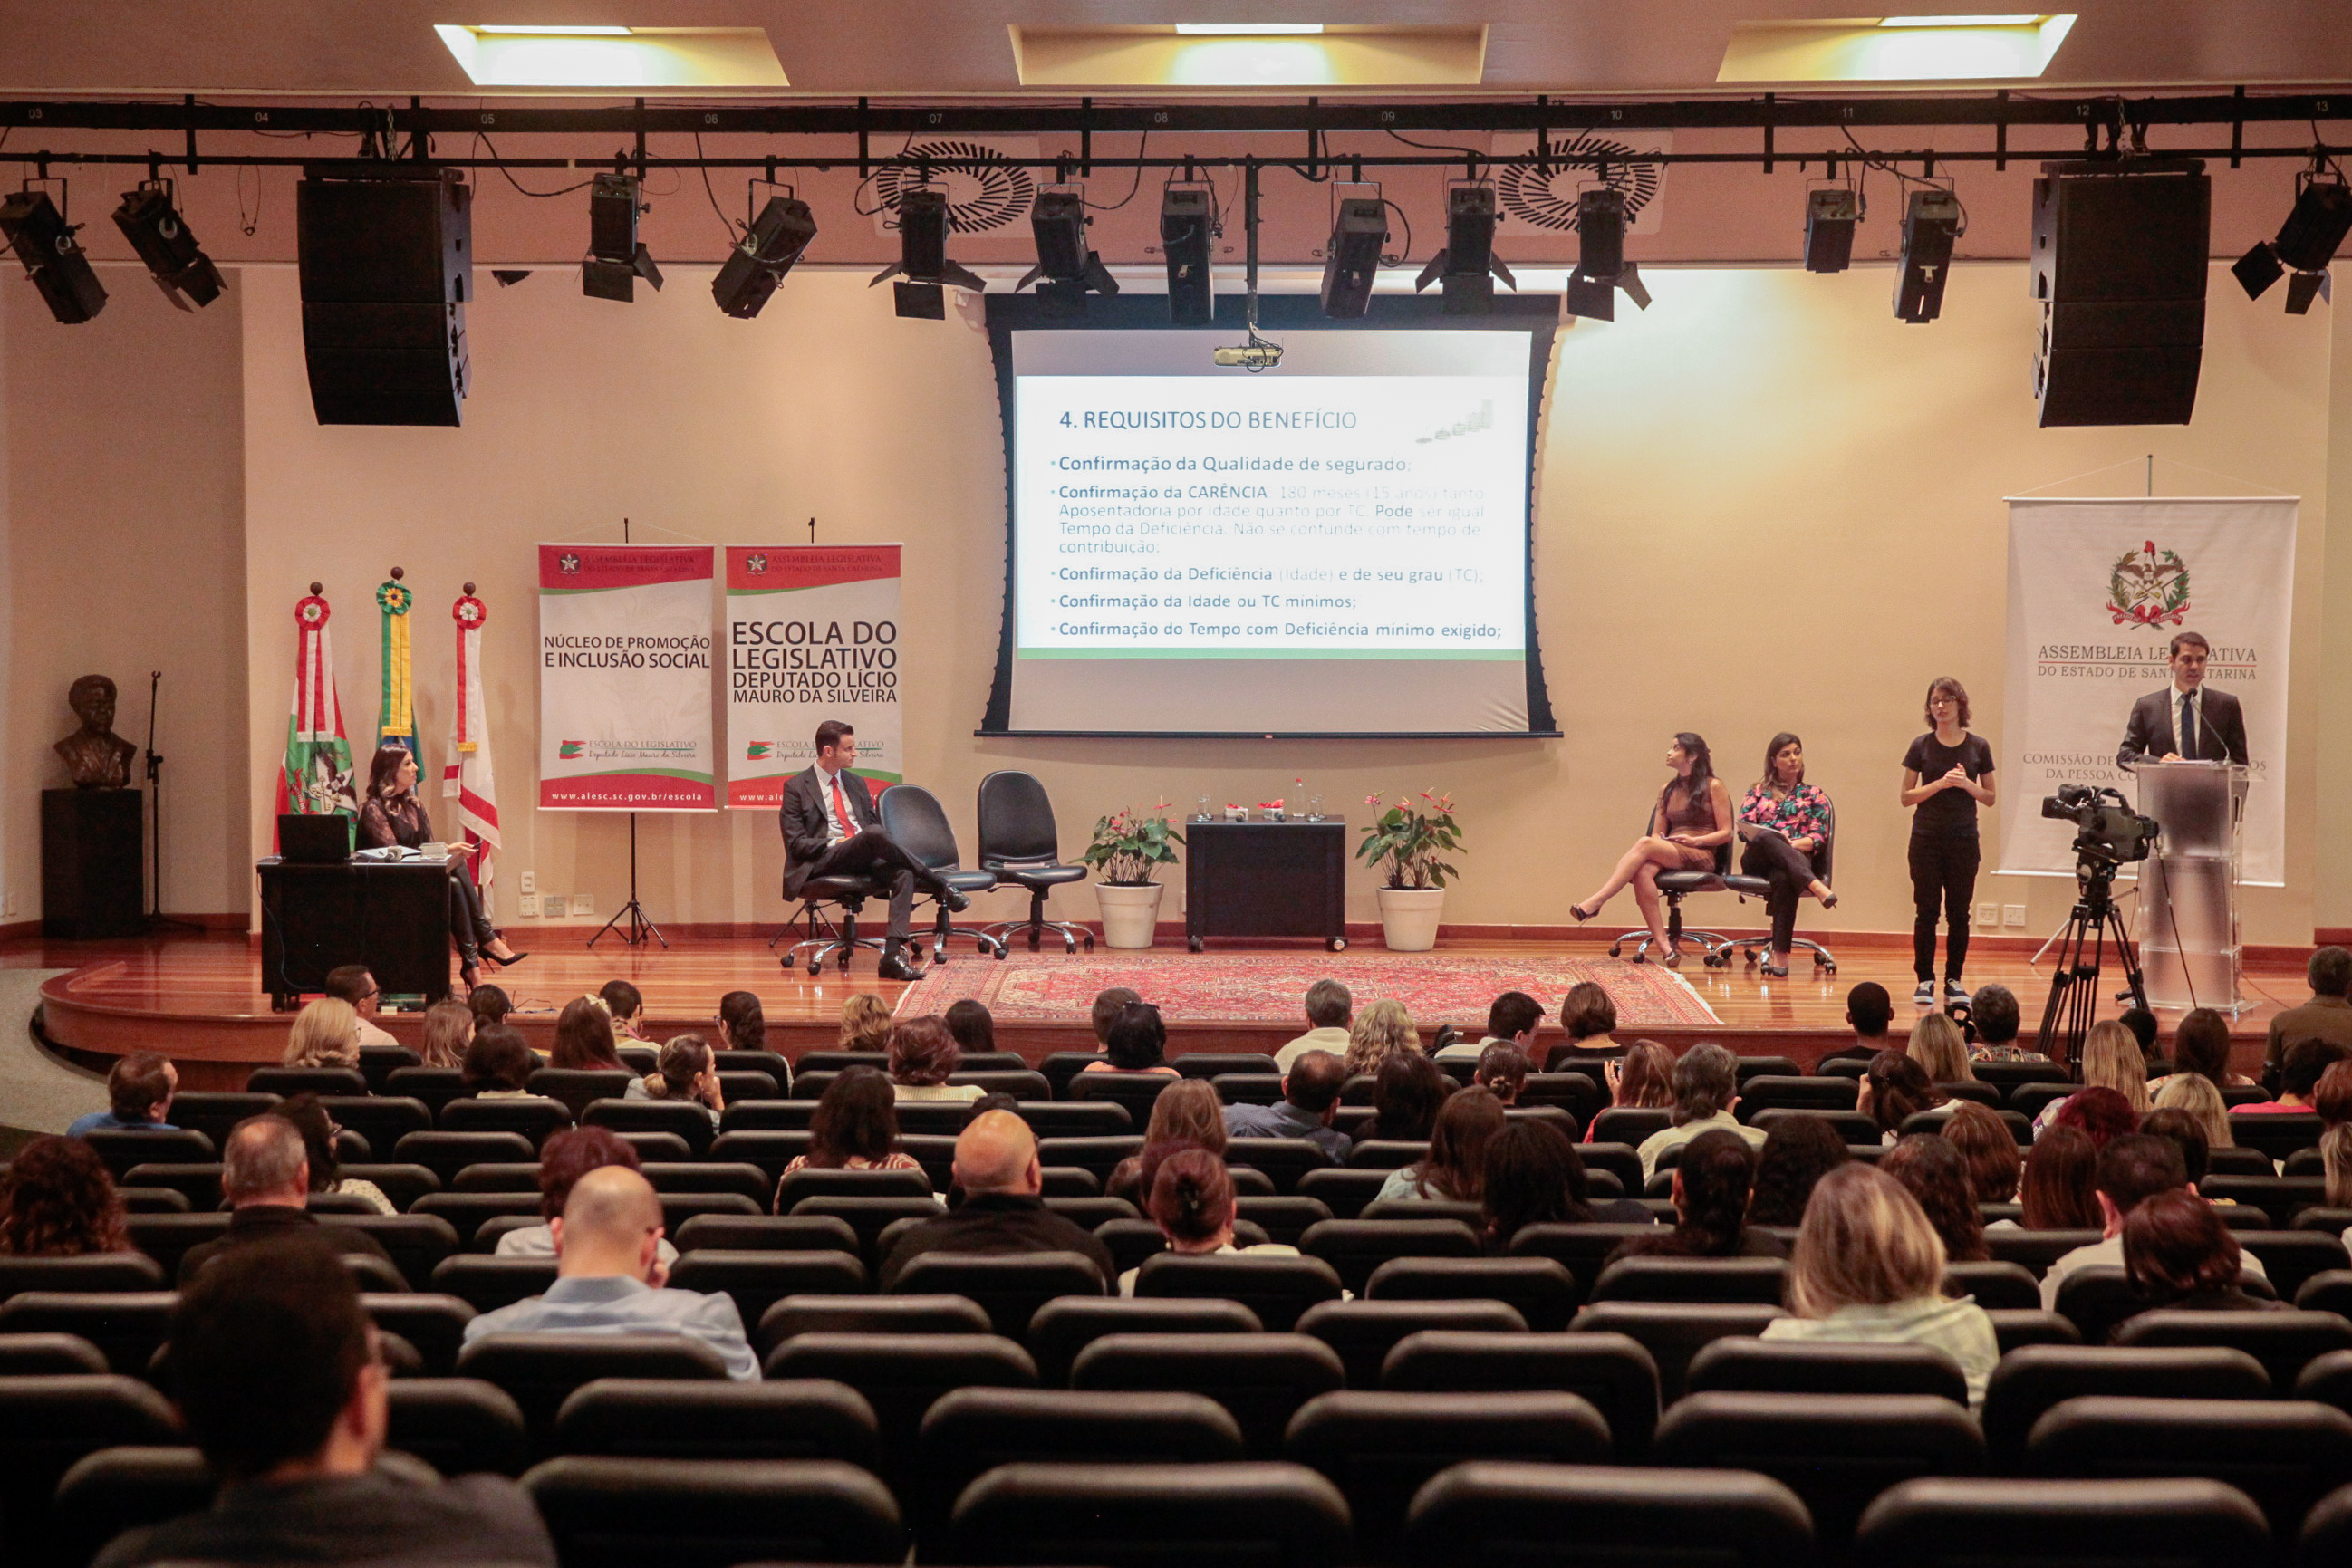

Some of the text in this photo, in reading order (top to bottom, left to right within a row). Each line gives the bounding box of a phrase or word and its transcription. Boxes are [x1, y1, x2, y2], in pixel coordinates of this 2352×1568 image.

[28, 107, 43, 119] 03
[1842, 107, 1854, 118] 11
[2077, 104, 2090, 116] 12
[2316, 101, 2328, 112] 13
[255, 111, 269, 123] 04
[480, 113, 496, 125] 05
[704, 113, 718, 125] 06
[929, 112, 943, 124] 07
[1153, 112, 1169, 123] 08
[1381, 111, 1395, 122] 09
[1610, 110, 1623, 120] 10
[1059, 408, 1357, 429] 4. REQUISITOS DO BENEFÍCIO
[1059, 455, 1412, 474] Confirmação da Qualidade de segurado;
[1059, 485, 1159, 502] Confirmação
[1164, 486, 1182, 499] da
[1189, 482, 1268, 499] CARÊNCIA
[1059, 504, 1171, 520] Aposentadoria
[1178, 507, 1203, 520] por
[1209, 504, 1250, 517] Idade
[1256, 505, 1310, 520] quanto
[1316, 507, 1342, 519] por
[1375, 504, 1413, 518] Pode
[1059, 521, 1480, 539] Tempo da Deficiência. Não se confunde com tempo de
[1059, 539, 1160, 556] contribuição;
[1059, 566, 1159, 582] Confirmação
[1164, 566, 1182, 581] da
[1189, 566, 1273, 581] Deficiência
[1279, 567, 1334, 582] (Idade)
[1339, 571, 1348, 581] e
[1353, 567, 1372, 581] de
[1377, 571, 1403, 582] seu
[1409, 571, 1443, 584] grau
[1059, 593, 1357, 611] Confirmação da Idade ou TC mínimos;
[732, 620, 898, 646] ESCOLA DO
[1059, 621, 1502, 640] Confirmação do Tempo com Deficiência mínimo exigido;
[545, 633, 711, 651] NÚCLEO DE PROMOÇÃO
[545, 650, 710, 669] E INCLUSÃO SOCIAL
[732, 647, 898, 669] LEGISLATIVO
[2038, 645, 2257, 662] ASSEMBLEIA LEATIVA
[733, 669, 898, 688] DEPUTADO LÍCIO
[2038, 666, 2174, 679] DO ESTADO DE SANT
[733, 688, 897, 704] MAURO DA SILVEIRA
[589, 740, 622, 748] ESCOLA
[641, 740, 697, 749] LEGISLATIVO
[2022, 752, 2115, 766] COMISSÃO DE
[2046, 768, 2064, 780] DA
[2068, 769, 2115, 781] PESSOA
[552, 792, 703, 803] www.alesc.sc.gov.br/escola
